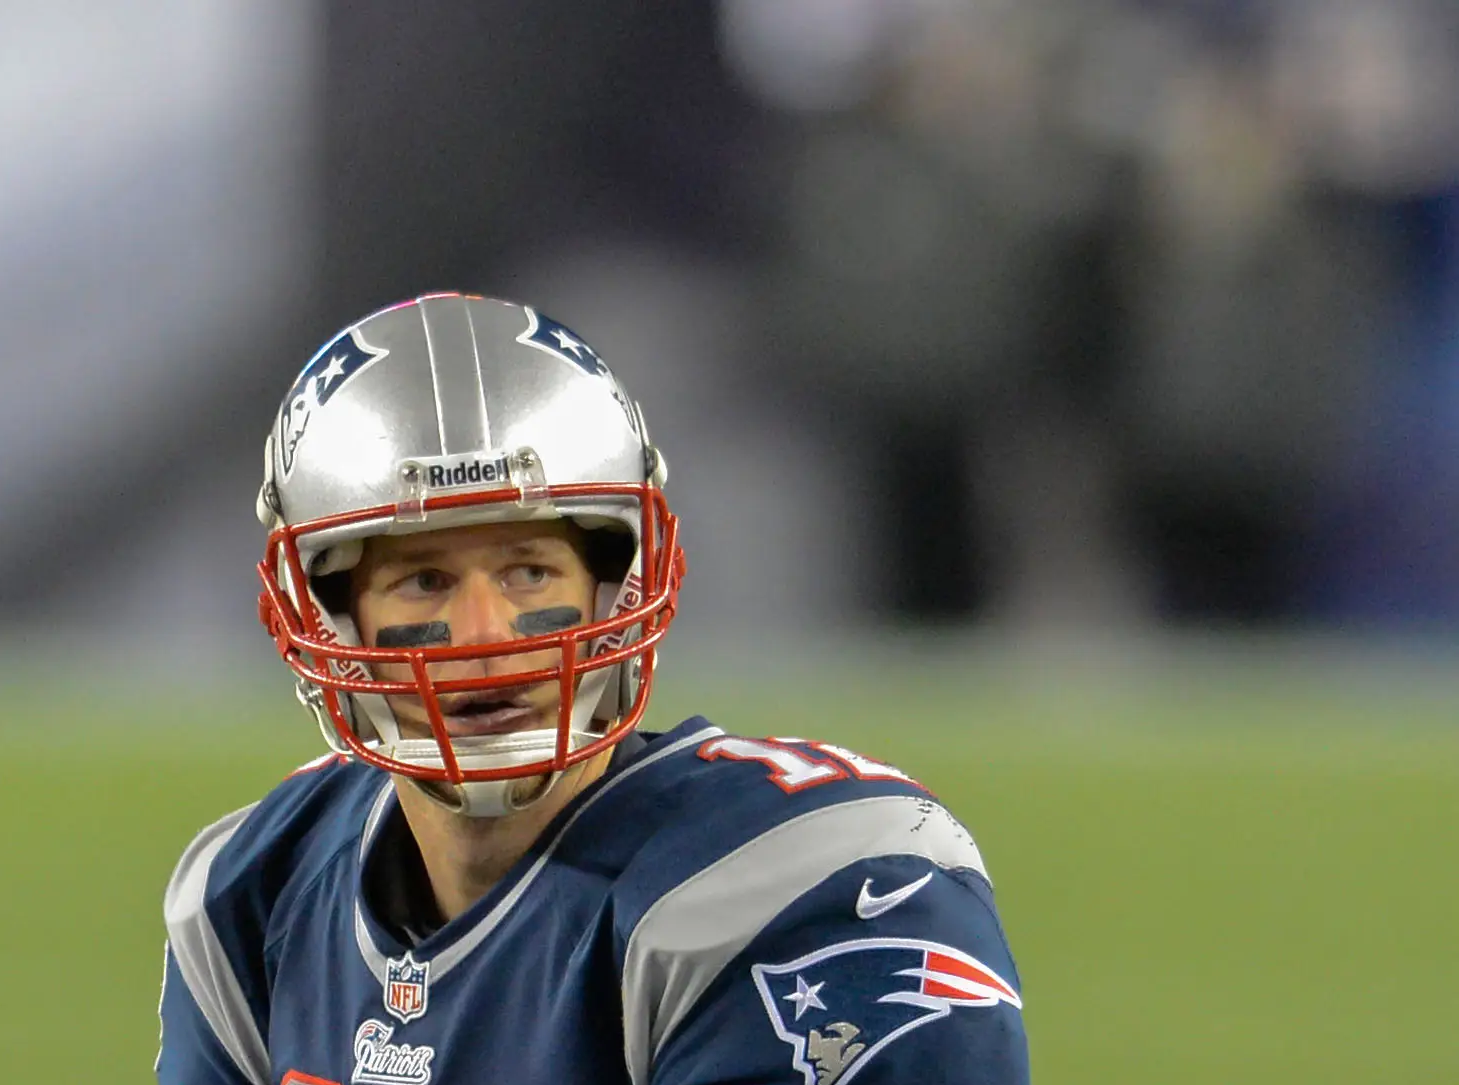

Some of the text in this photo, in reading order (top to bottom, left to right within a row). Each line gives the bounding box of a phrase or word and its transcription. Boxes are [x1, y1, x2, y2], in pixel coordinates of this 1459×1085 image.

[428, 456, 511, 489] Riddell
[595, 571, 643, 656] Riell
[390, 982, 422, 1012] NFL
[354, 1039, 433, 1083] Patriots
